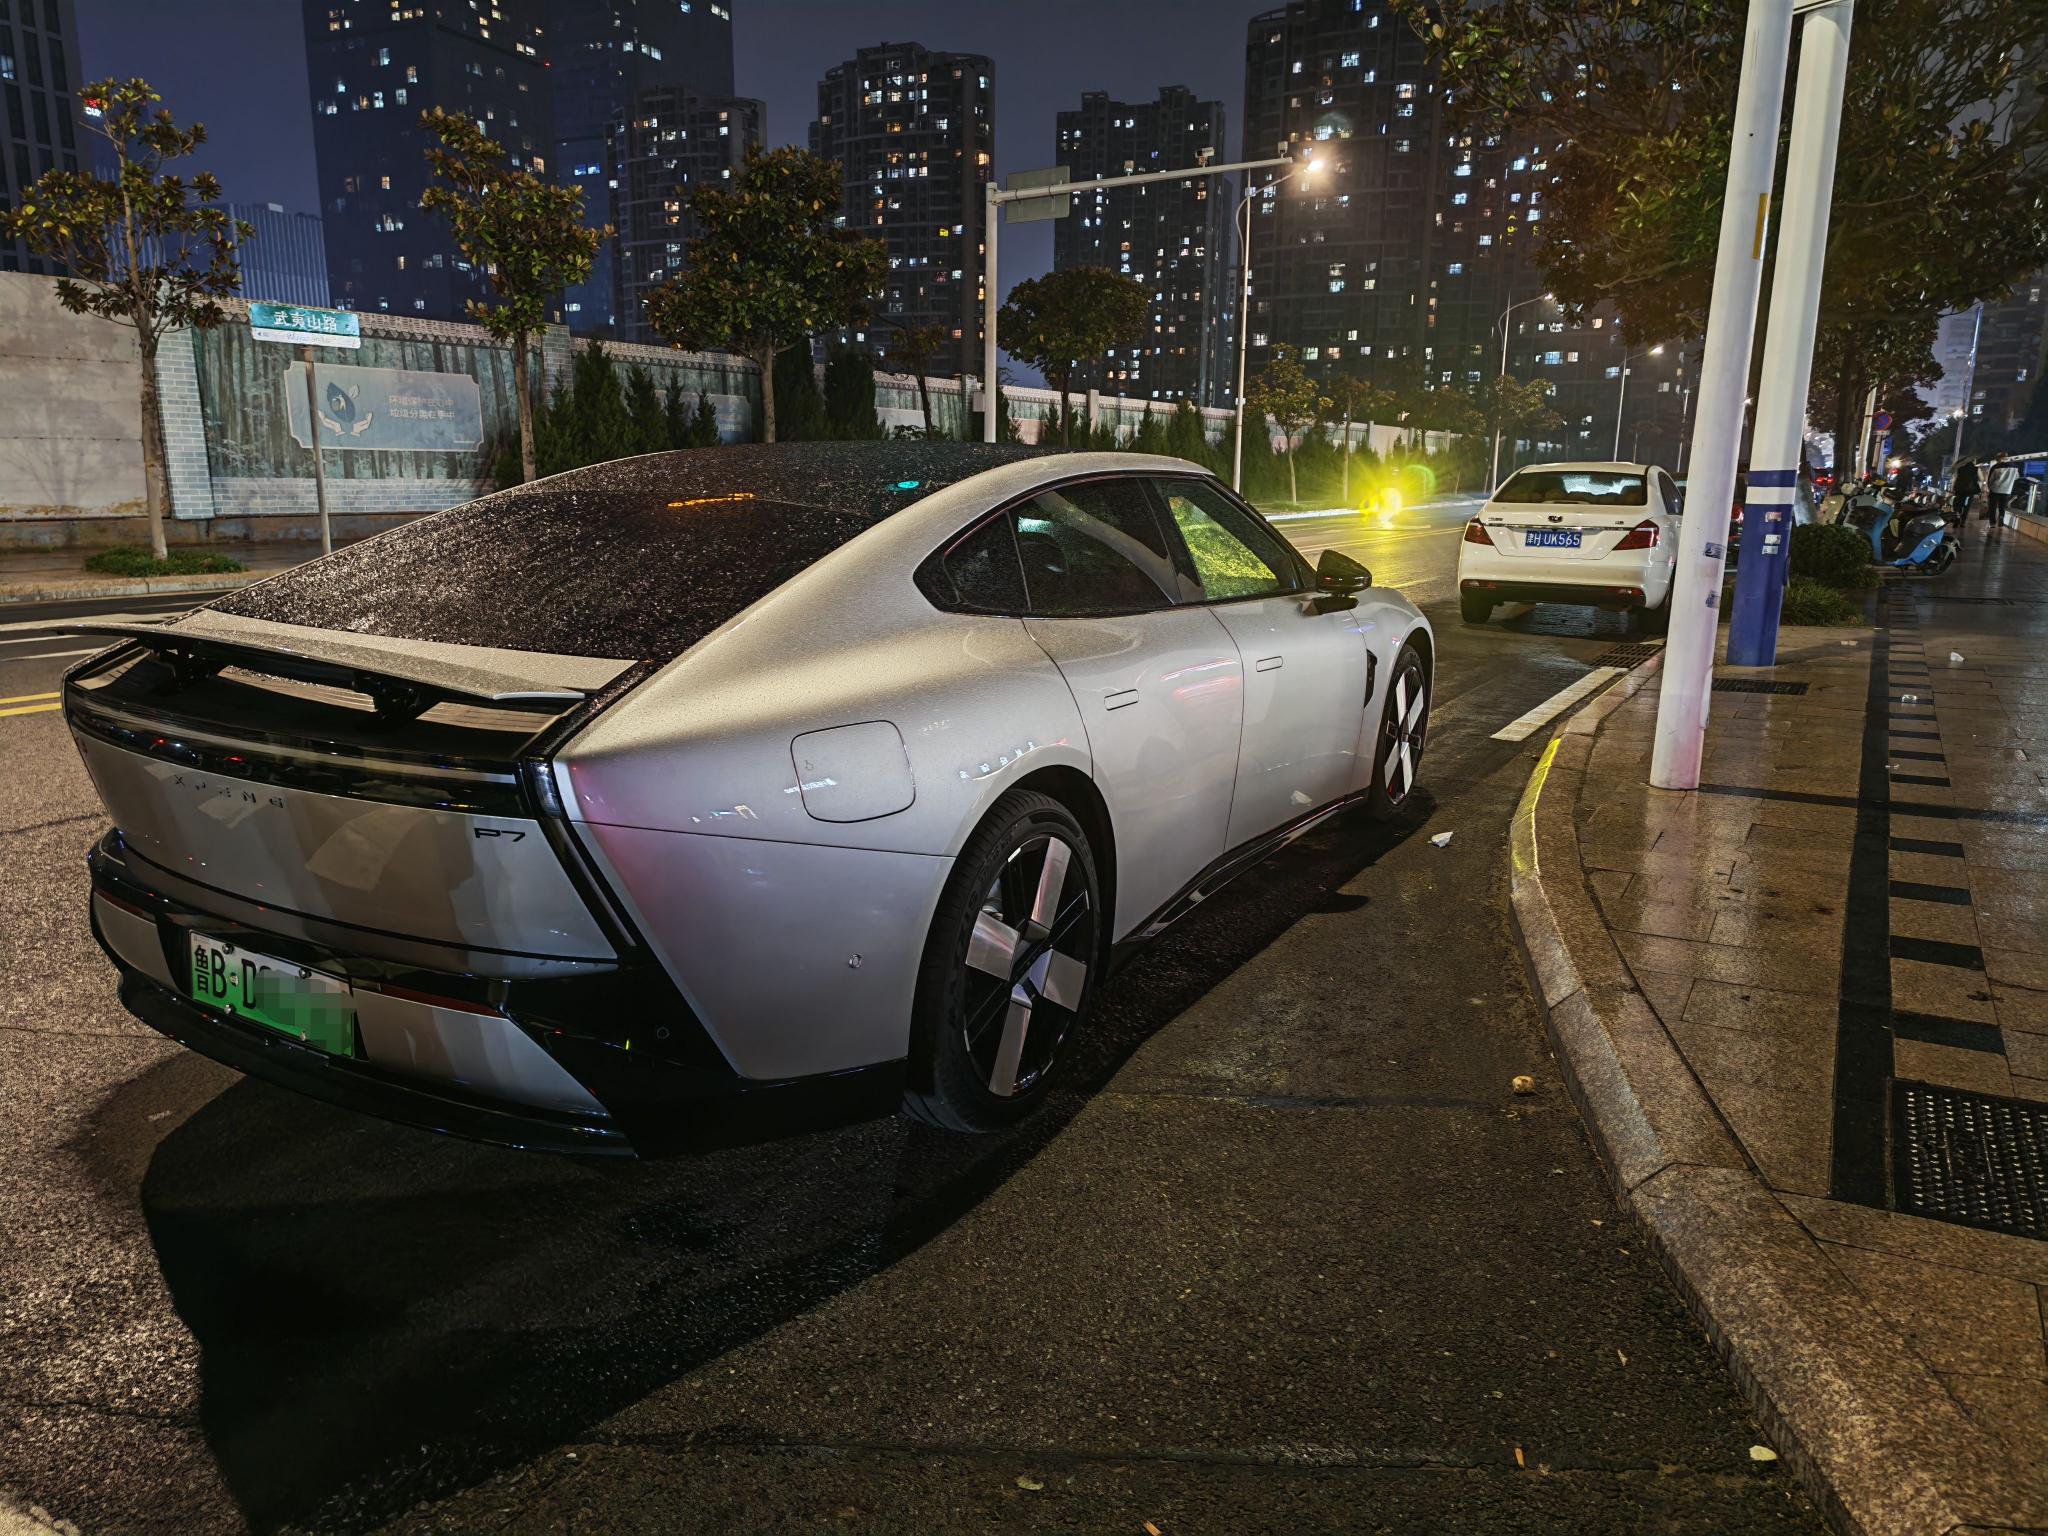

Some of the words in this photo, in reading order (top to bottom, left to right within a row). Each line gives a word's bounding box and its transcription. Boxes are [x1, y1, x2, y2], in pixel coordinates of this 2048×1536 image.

[273, 310, 337, 333] 武夷山路
[473, 827, 526, 843] P7
